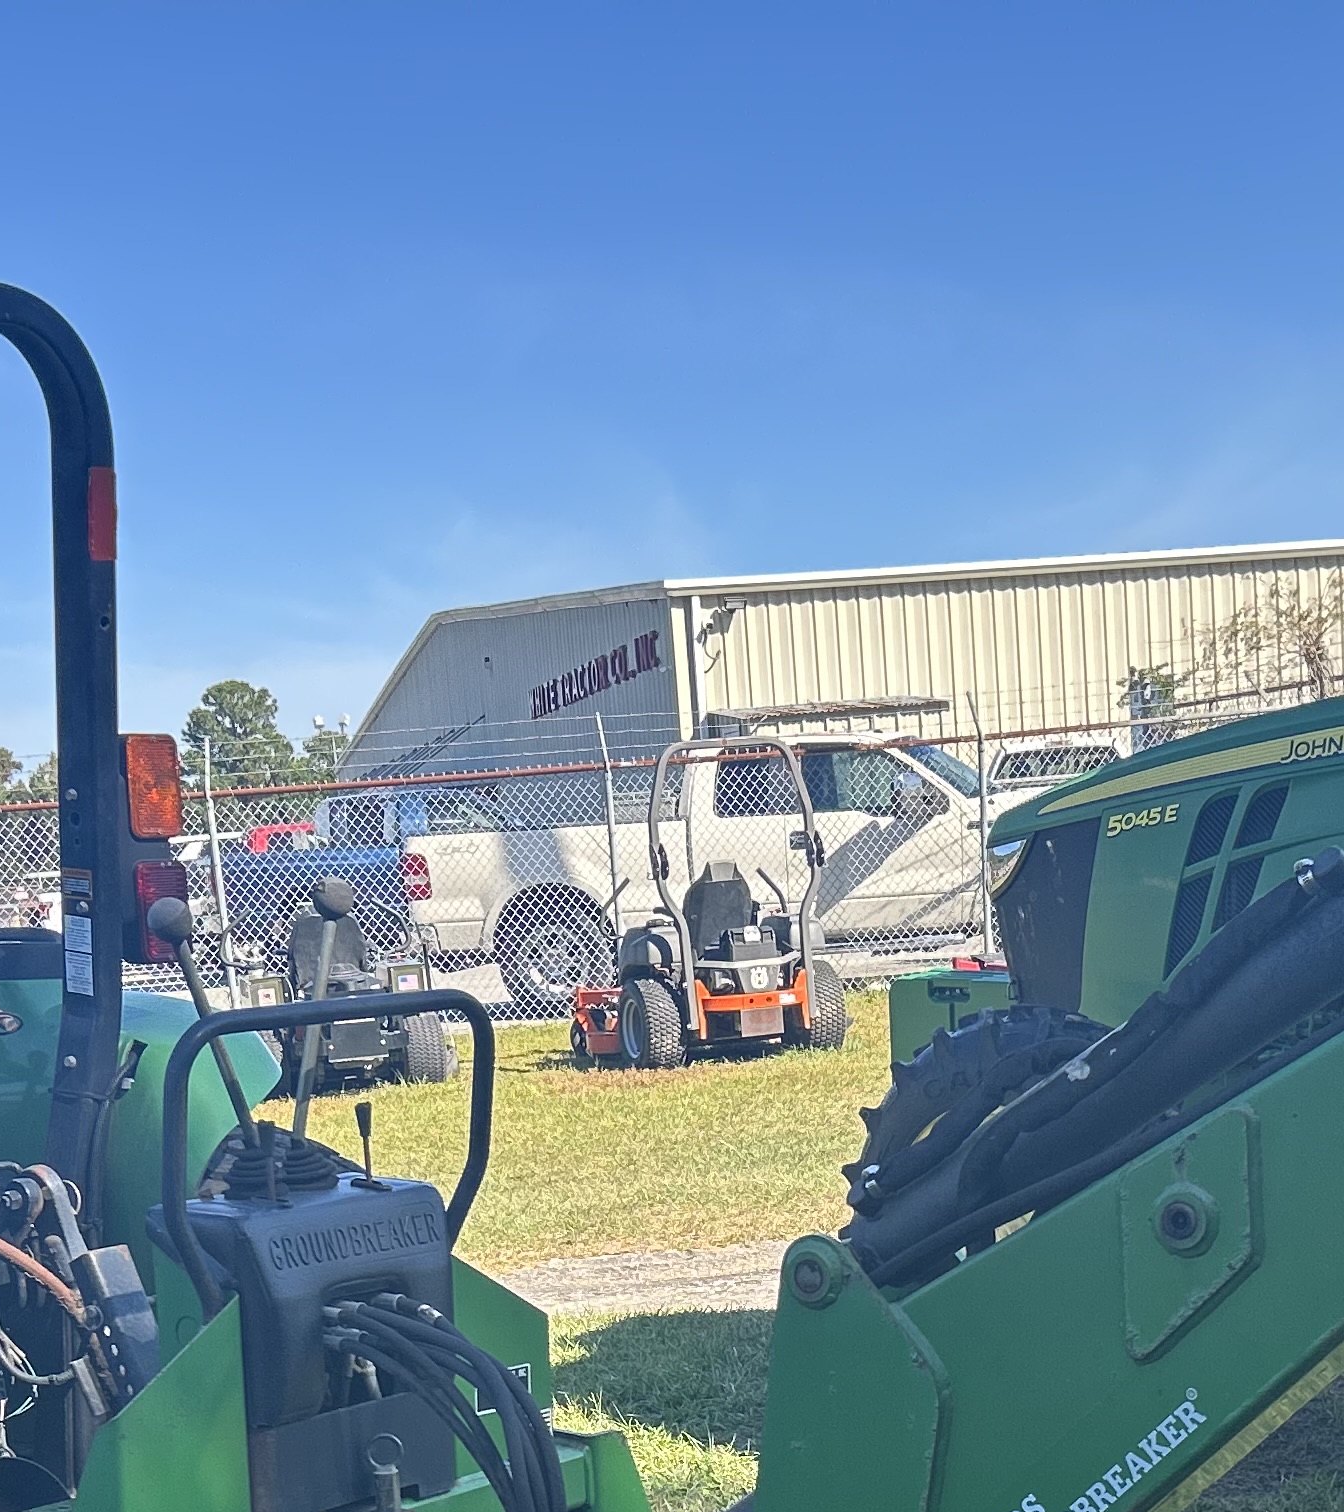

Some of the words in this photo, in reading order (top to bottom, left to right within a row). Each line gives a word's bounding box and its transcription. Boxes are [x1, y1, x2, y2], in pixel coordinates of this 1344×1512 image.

[528, 679, 559, 719] WHITE
[557, 654, 609, 707] TRACTOR
[1280, 733, 1344, 763] JOHN
[1106, 806, 1163, 837] 5045
[1164, 803, 1180, 823] E
[269, 1212, 441, 1271] GROUNDBREAKER
